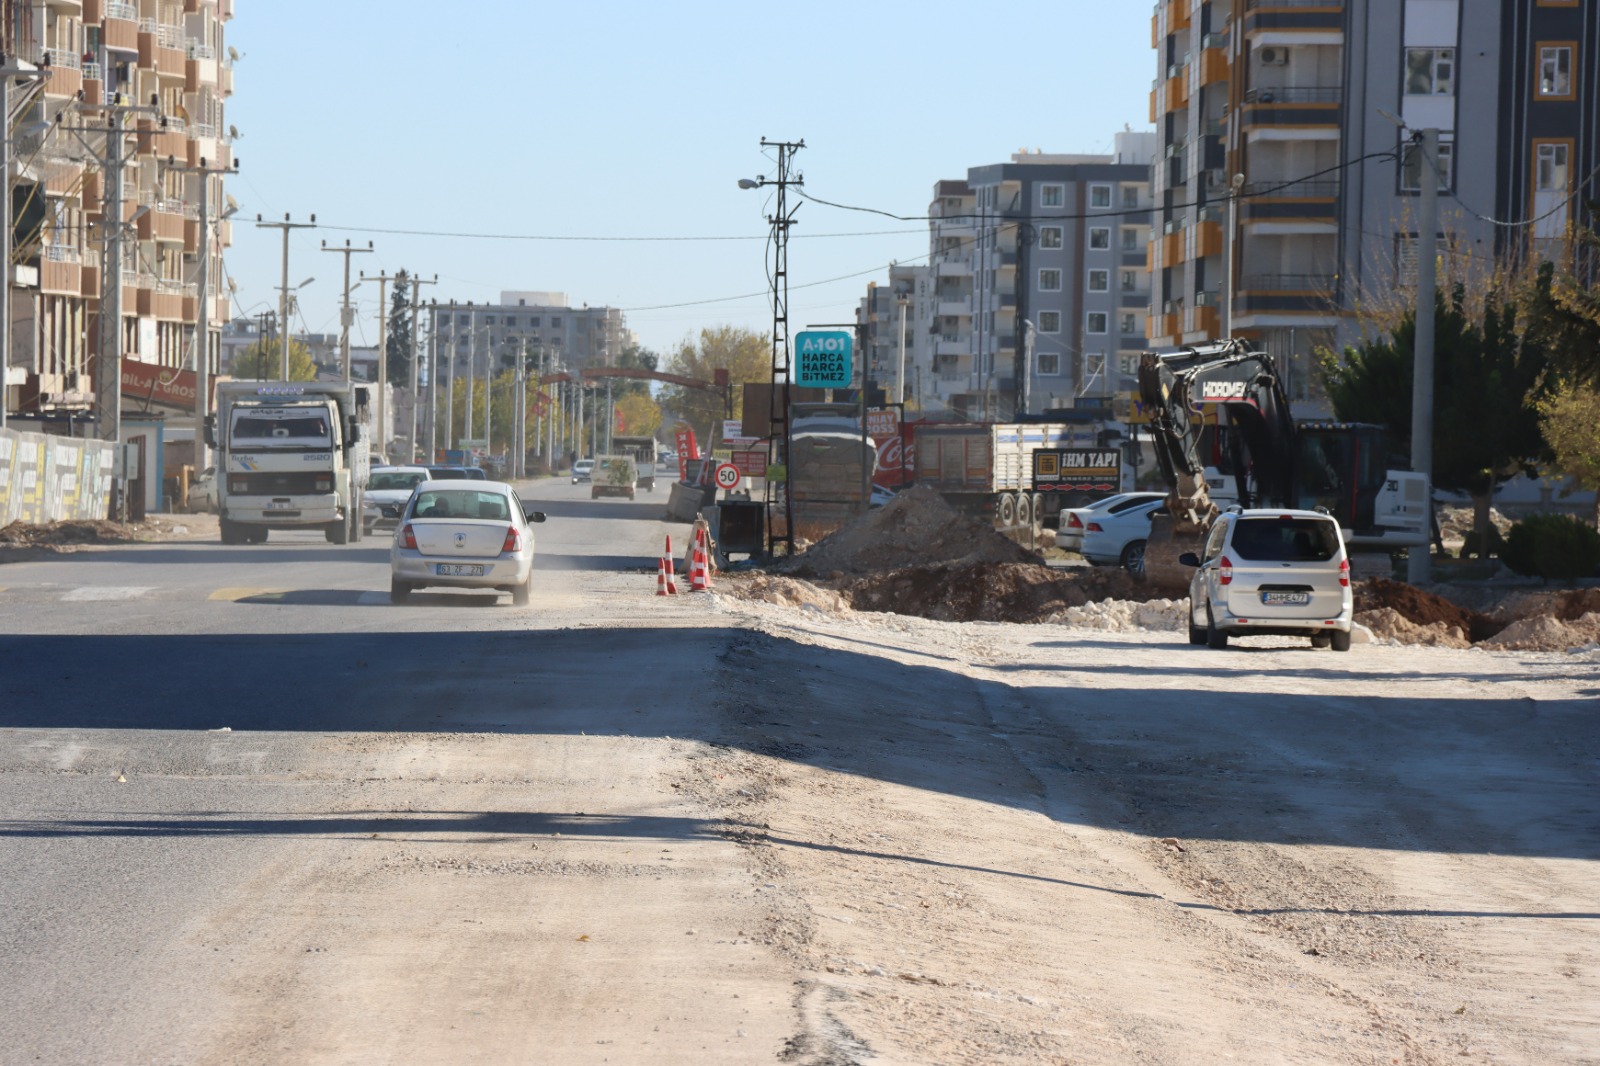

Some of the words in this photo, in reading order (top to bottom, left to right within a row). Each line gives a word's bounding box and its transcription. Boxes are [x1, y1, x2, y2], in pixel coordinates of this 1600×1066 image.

[802, 353, 844, 362] HARCA
[802, 363, 844, 372] HARCA
[1088, 452, 1118, 467] YAPI
[720, 470, 736, 482] 50
[441, 565, 451, 573] 63
